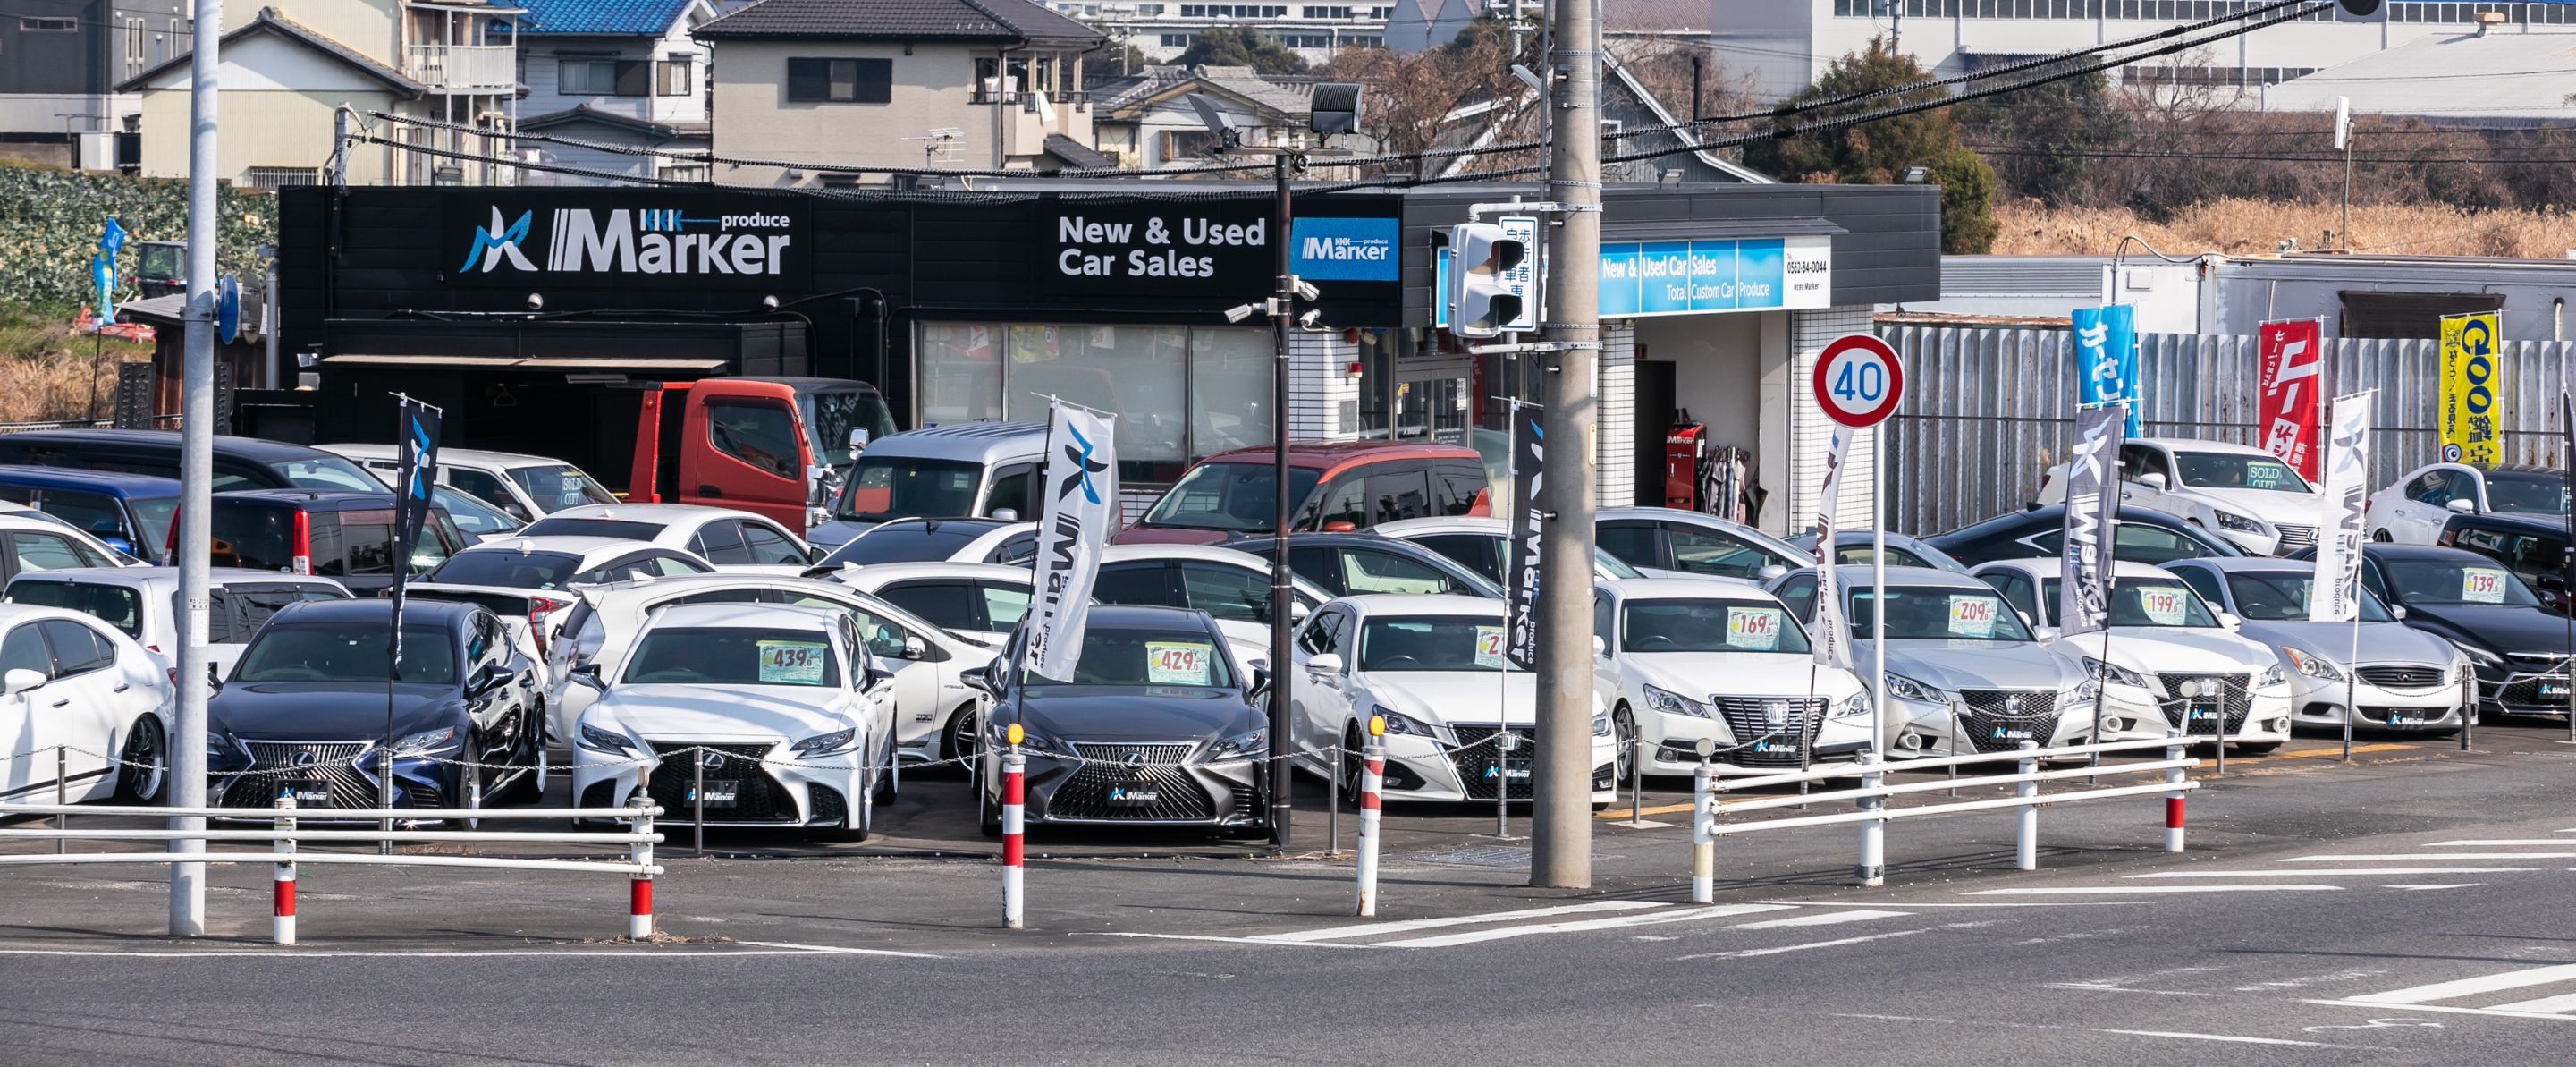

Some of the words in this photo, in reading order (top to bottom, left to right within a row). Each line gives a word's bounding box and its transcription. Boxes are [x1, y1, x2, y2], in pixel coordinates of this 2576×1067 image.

[722, 212, 790, 231] produce
[1060, 216, 1133, 244] New
[1145, 217, 1170, 244] &
[1183, 217, 1265, 246] Used
[547, 208, 790, 275] Marker
[1302, 237, 1389, 260] Marker
[1059, 249, 1115, 276] Car
[1128, 249, 1214, 277] Sales
[1602, 258, 1626, 279] New
[1628, 256, 1637, 278] &
[1643, 256, 1667, 277] Used
[1669, 255, 1687, 275] Car
[1692, 254, 1716, 275] Sales
[1787, 260, 1827, 274] 0562-84-0044
[1667, 284, 1686, 301] Total
[1691, 283, 1719, 300] Custom
[1721, 283, 1734, 299] Car
[1739, 283, 1769, 297] Produce
[1834, 361, 1882, 402] 40
[2250, 467, 2279, 478] SOLD
[563, 478, 581, 490] SOLD
[564, 493, 579, 505] OUT
[1039, 623, 1051, 669] produce
[1526, 621, 1536, 665] produce
[1827, 618, 1835, 662] produce
[296, 791, 327, 800] Marker
[704, 792, 735, 800] Marker
[1127, 792, 1157, 800] Marker
